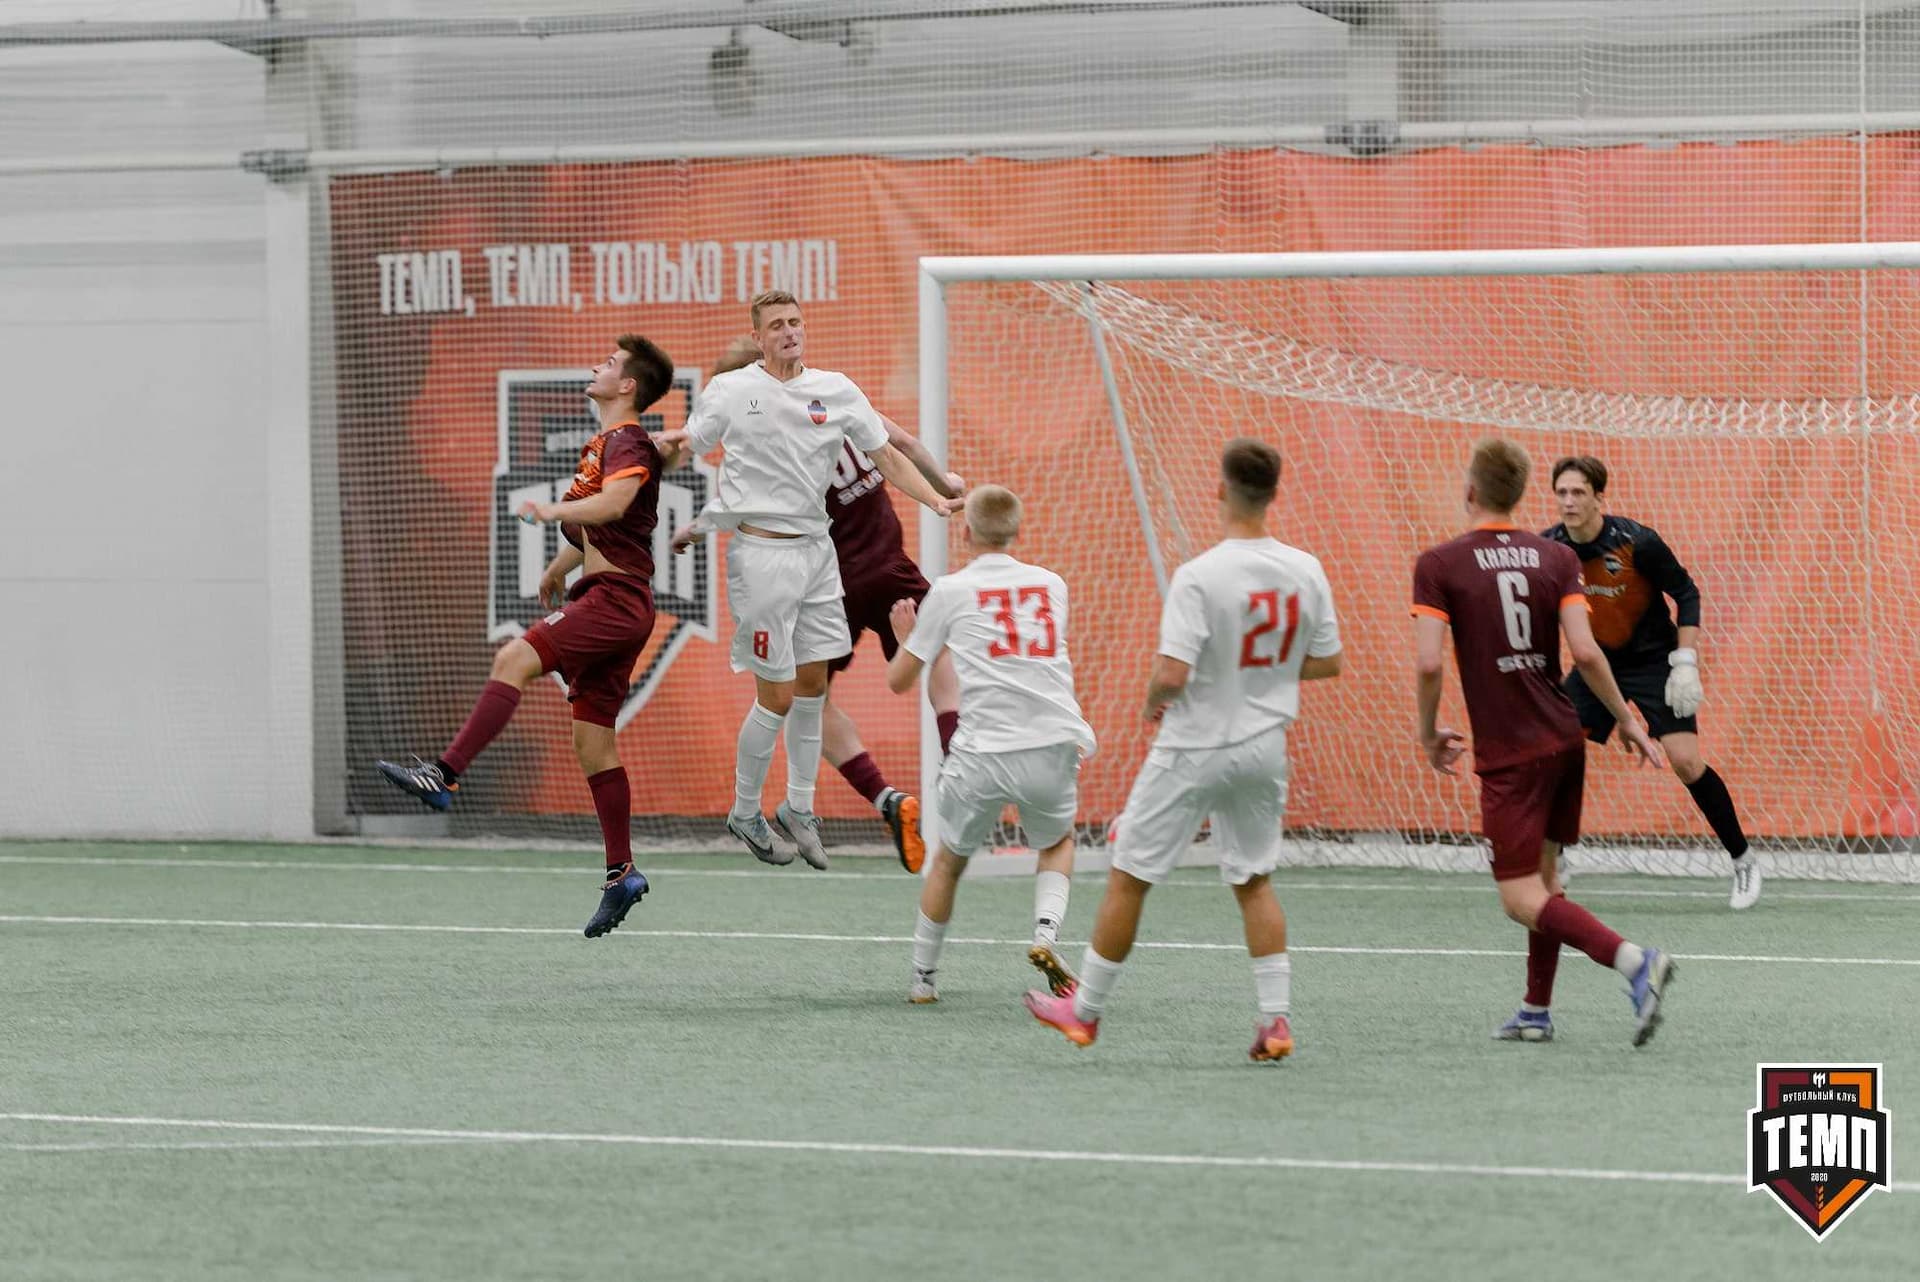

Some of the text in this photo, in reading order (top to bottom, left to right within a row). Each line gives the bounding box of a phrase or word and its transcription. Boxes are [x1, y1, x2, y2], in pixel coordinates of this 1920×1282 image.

[377, 239, 839, 317] ТЕМП, ТЕМП, ТОЛЬКО ТЕМП!
[1473, 546, 1541, 571] КНЯЗЕВ
[753, 630, 769, 661] 8
[976, 584, 1058, 660] 33
[1239, 588, 1300, 671] 21
[1496, 570, 1533, 652] 6
